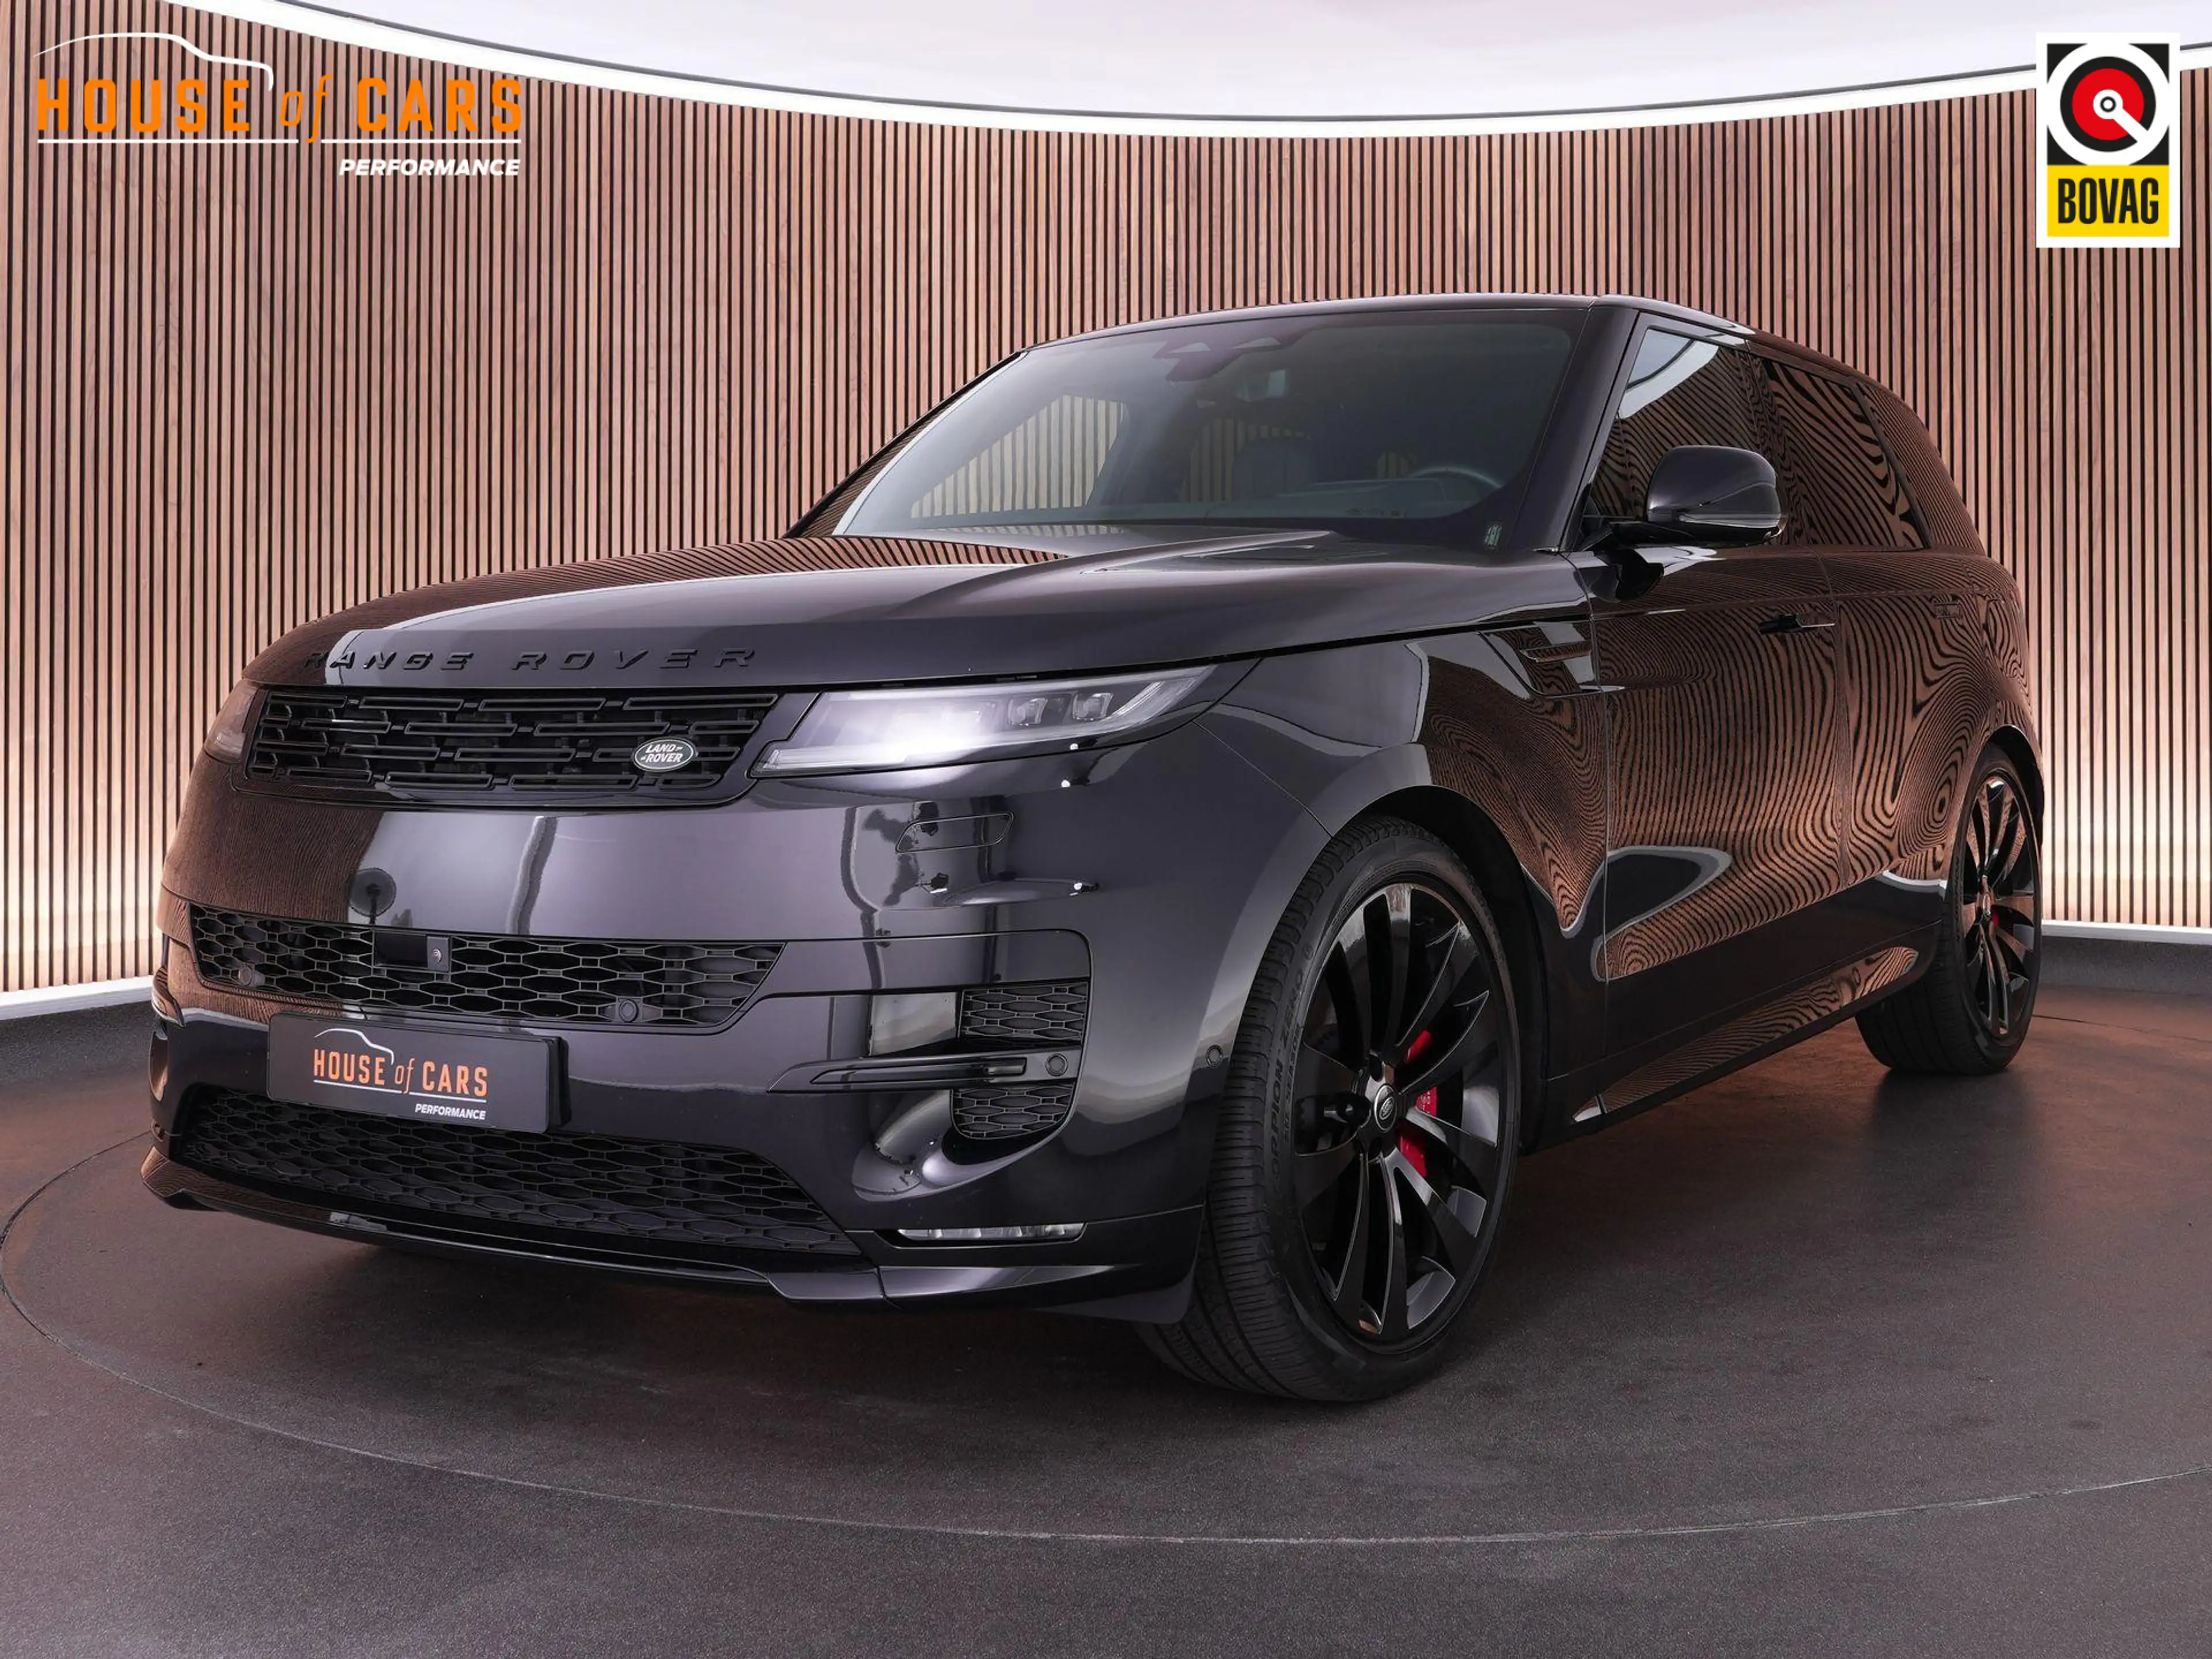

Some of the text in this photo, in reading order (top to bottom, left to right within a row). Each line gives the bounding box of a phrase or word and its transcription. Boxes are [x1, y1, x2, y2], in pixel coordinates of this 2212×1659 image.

[304, 649, 756, 671] RANGE ROVER
[313, 1048, 488, 1097] HOUSE of CARS
[414, 1103, 486, 1121] PERFORMANCE
